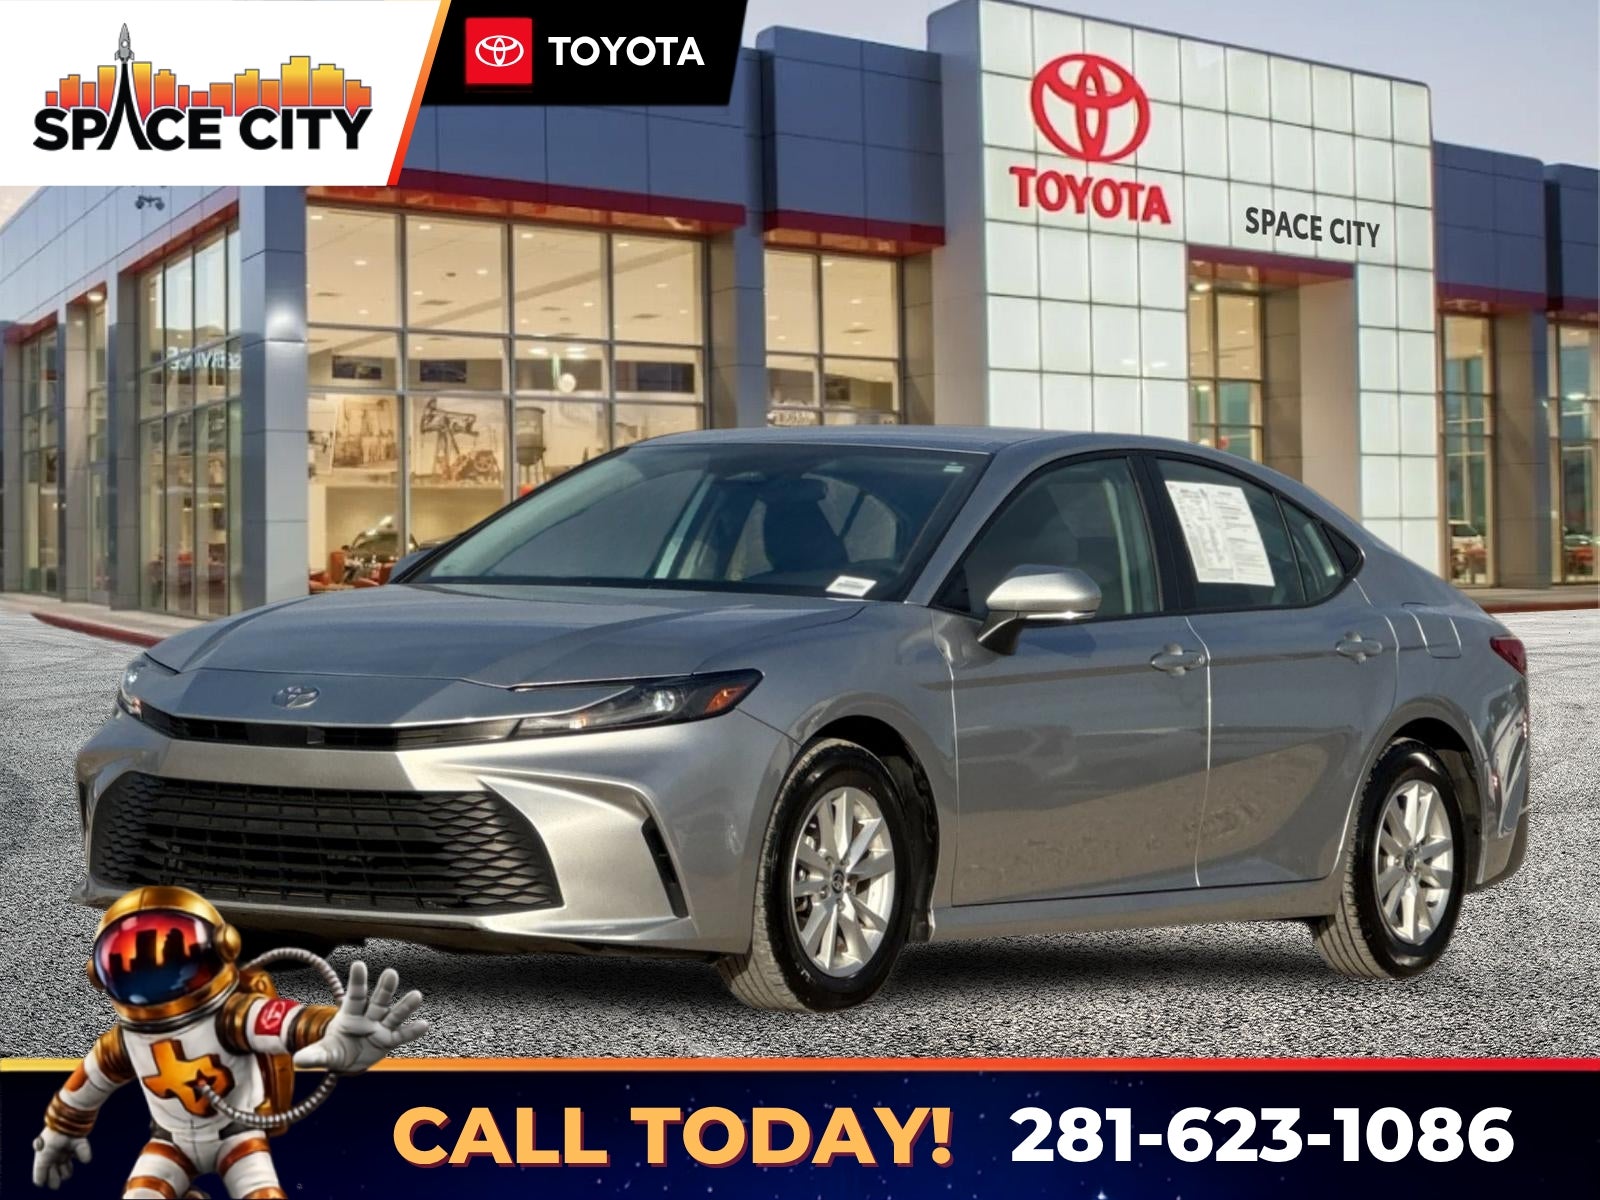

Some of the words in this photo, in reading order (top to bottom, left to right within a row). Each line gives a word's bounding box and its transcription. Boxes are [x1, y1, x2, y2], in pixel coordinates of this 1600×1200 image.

[1009, 166, 1171, 224] TOYOTA
[1245, 206, 1322, 242] SPACE
[1329, 217, 1381, 248] CITY
